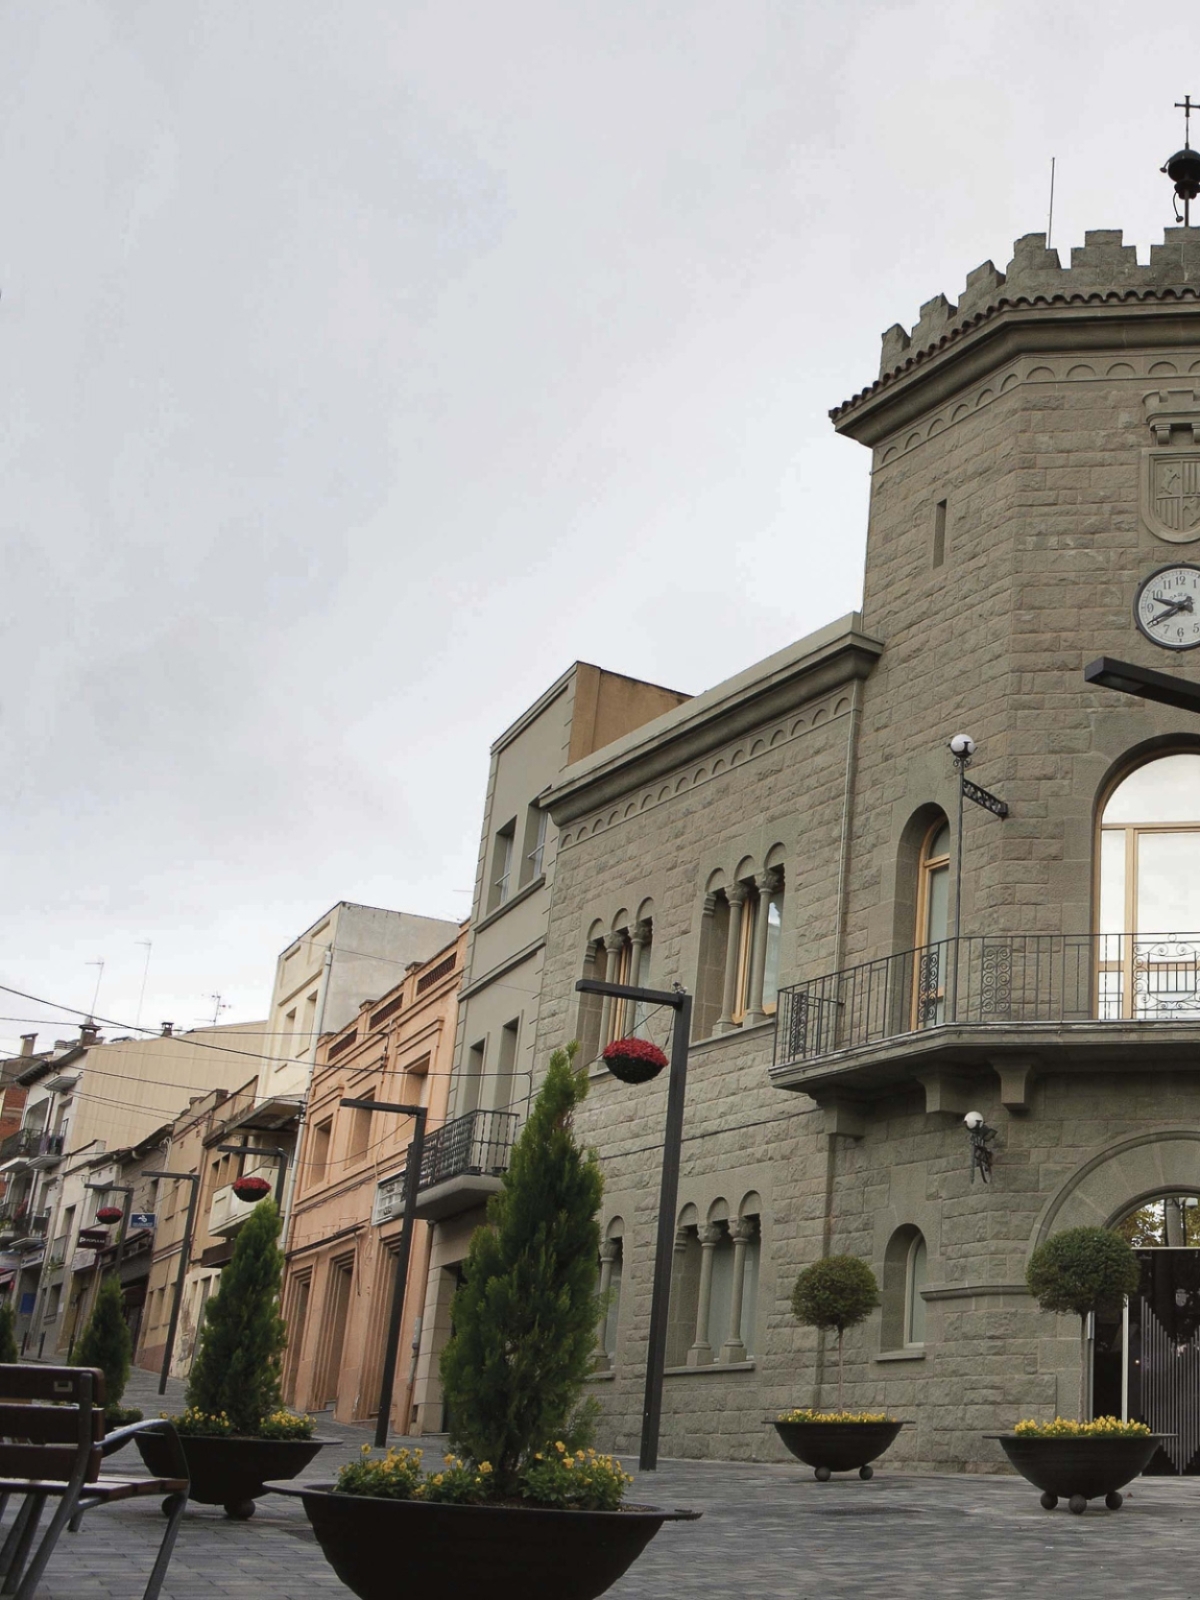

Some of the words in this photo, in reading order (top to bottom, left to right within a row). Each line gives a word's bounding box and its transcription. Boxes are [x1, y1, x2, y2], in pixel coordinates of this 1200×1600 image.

[1163, 580, 1171, 590] 11
[1175, 576, 1186, 585] 12
[1193, 579, 1197, 589] 1
[1152, 590, 1163, 599] 10
[1147, 602, 1154, 613] 9
[1163, 624, 1170, 635] 7
[1177, 627, 1184, 638] 6
[1193, 623, 1199, 633] 5
